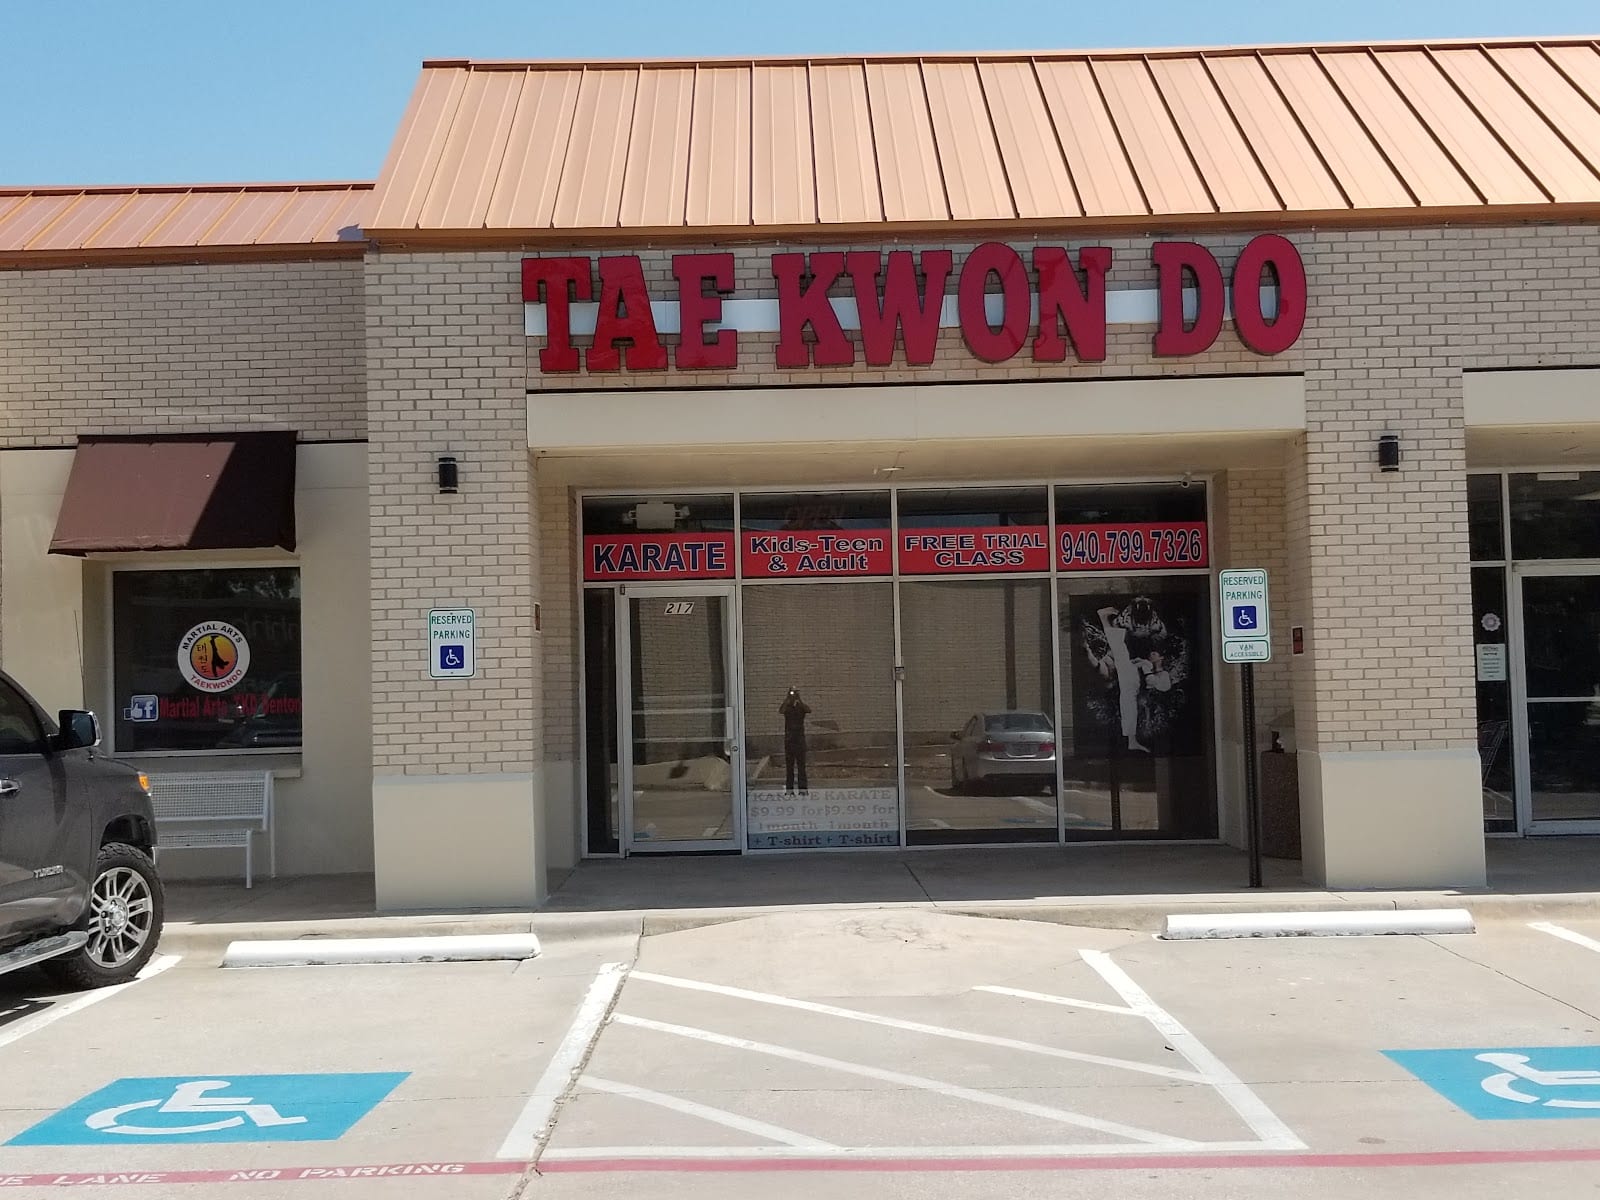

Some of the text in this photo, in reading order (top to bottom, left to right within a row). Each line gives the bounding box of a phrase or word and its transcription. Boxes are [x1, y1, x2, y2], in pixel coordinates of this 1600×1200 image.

[521, 233, 1308, 373] TAE KWON DO
[750, 535, 884, 554] Kids-Teen
[904, 533, 1047, 551] FREE TRIAL
[1061, 529, 1201, 565] 940.799.7326
[593, 542, 727, 573] KARATE
[768, 553, 868, 572] & Adult
[935, 550, 1025, 567] CLASS
[1223, 576, 1264, 586] RESERVED
[1226, 590, 1263, 600] PARKING
[665, 603, 694, 614] 217
[431, 615, 473, 625] RESERVED
[182, 624, 243, 650] MARTIAL ARTS
[433, 630, 470, 640] PARKING
[1240, 643, 1254, 651] VAN
[191, 669, 243, 689] TAEKWONDO
[160, 695, 200, 718] Martial
[825, 789, 891, 800] KARATE
[872, 804, 895, 814] for
[768, 835, 822, 846] T-shirt
[838, 833, 894, 845] T-shirt
[53, 1173, 167, 1185] LANE
[229, 1170, 282, 1182] NO
[299, 1163, 465, 1178] PARKING
